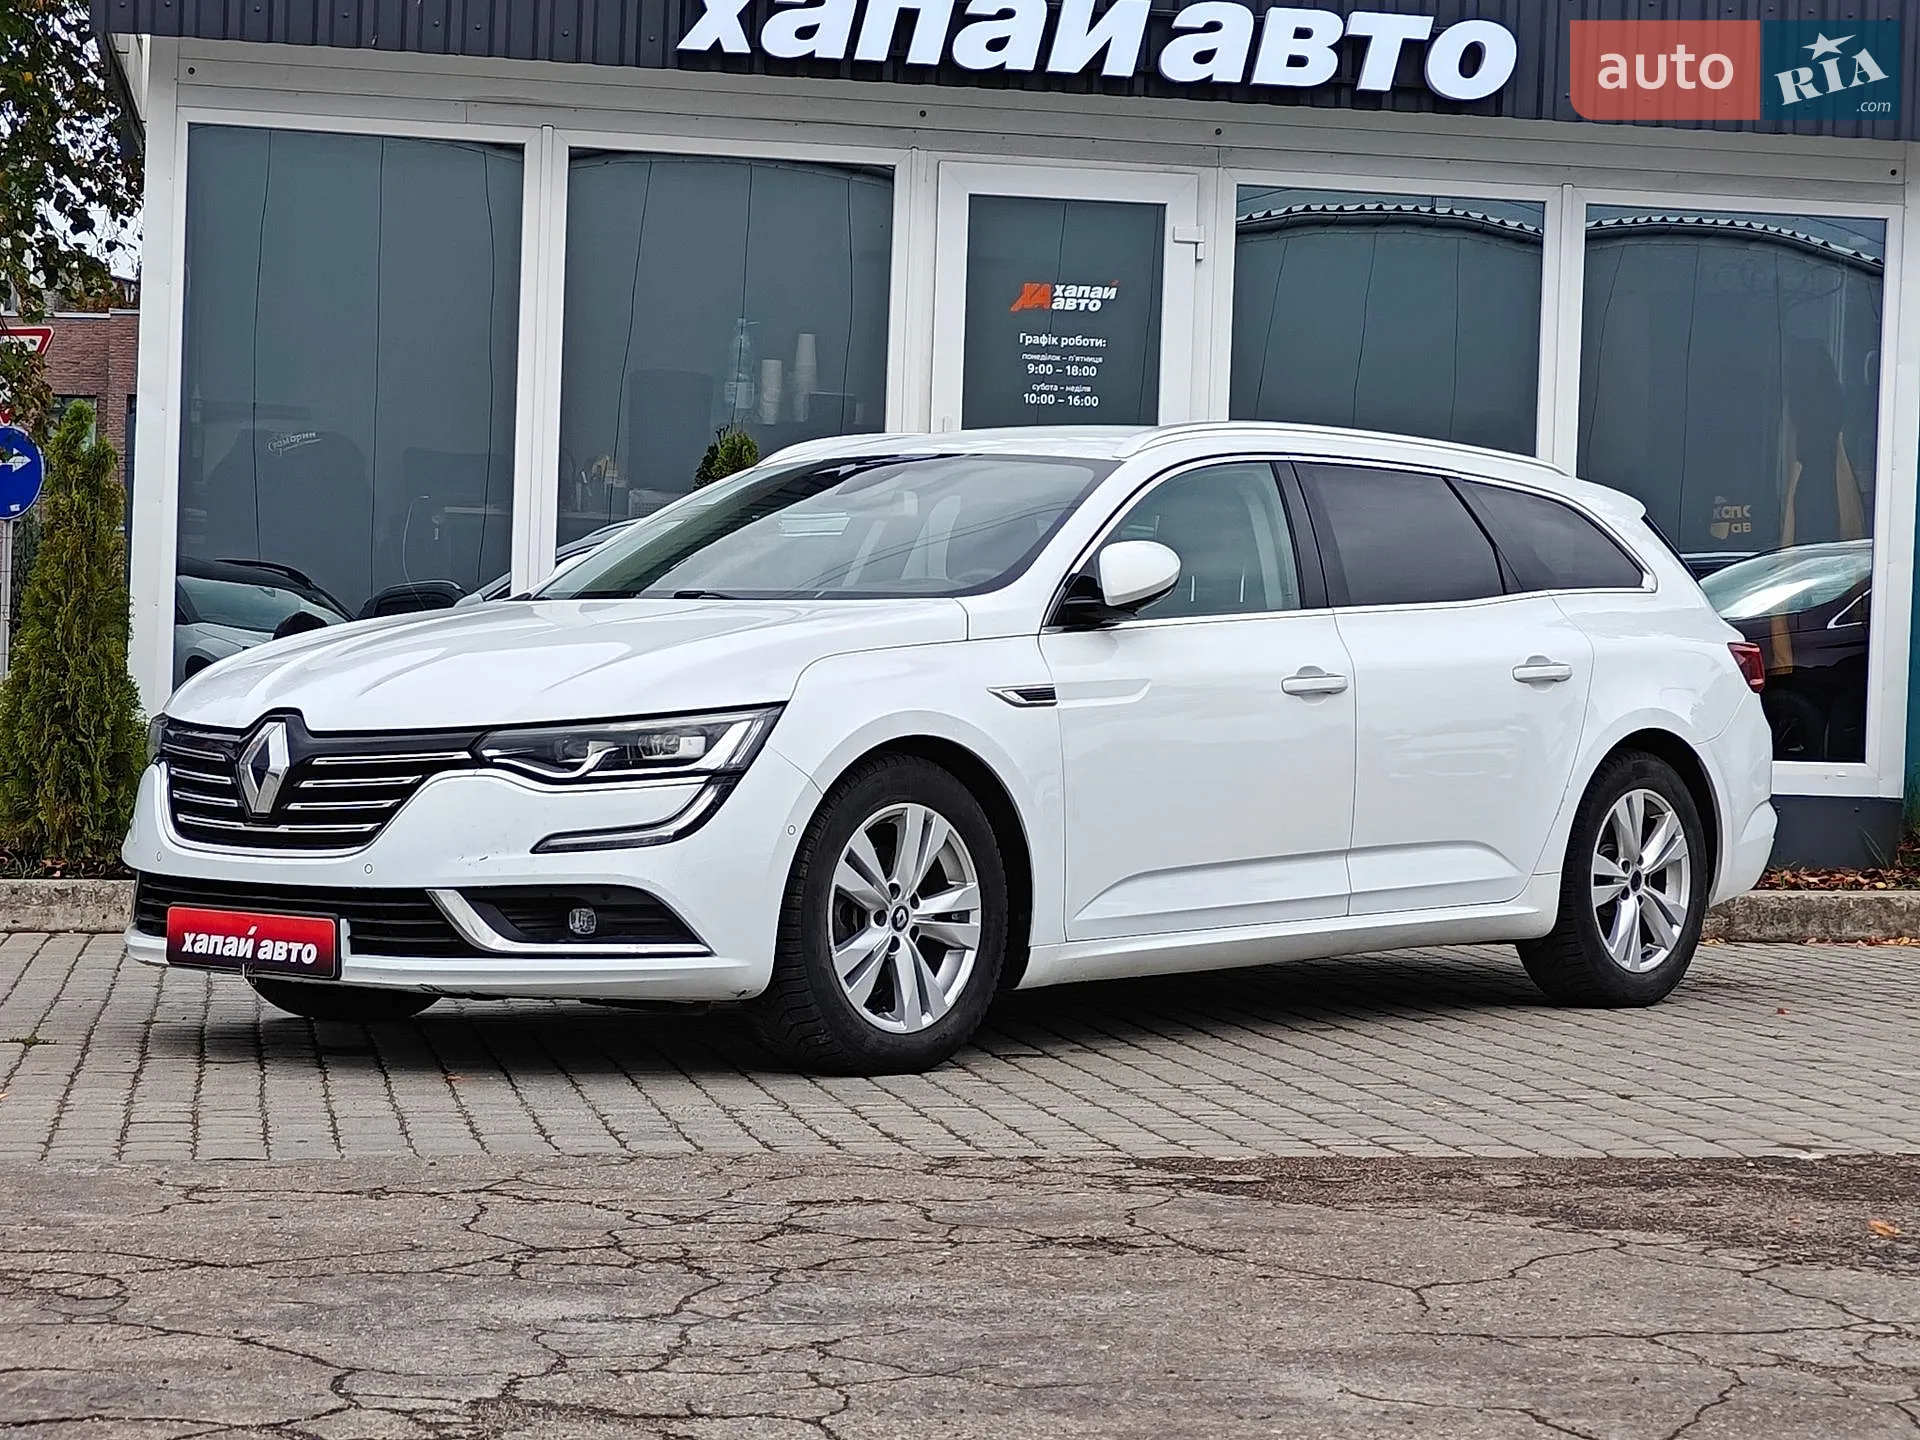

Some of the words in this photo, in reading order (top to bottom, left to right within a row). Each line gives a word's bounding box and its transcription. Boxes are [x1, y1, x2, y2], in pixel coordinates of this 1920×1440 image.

[1158, 1, 1518, 100] авто
[1051, 297, 1102, 312] авто
[1019, 333, 1058, 347] Графік
[1060, 335, 1107, 348] роботи:
[1021, 353, 1061, 361] понеділок
[1027, 363, 1053, 375] 9:00
[1065, 365, 1097, 377] 18:00
[1032, 383, 1058, 392] субота
[1065, 385, 1092, 393] неділя
[1023, 393, 1055, 405] 10:00
[1067, 395, 1099, 407] 16:00
[181, 925, 258, 959] хапай
[257, 938, 318, 965] авто
